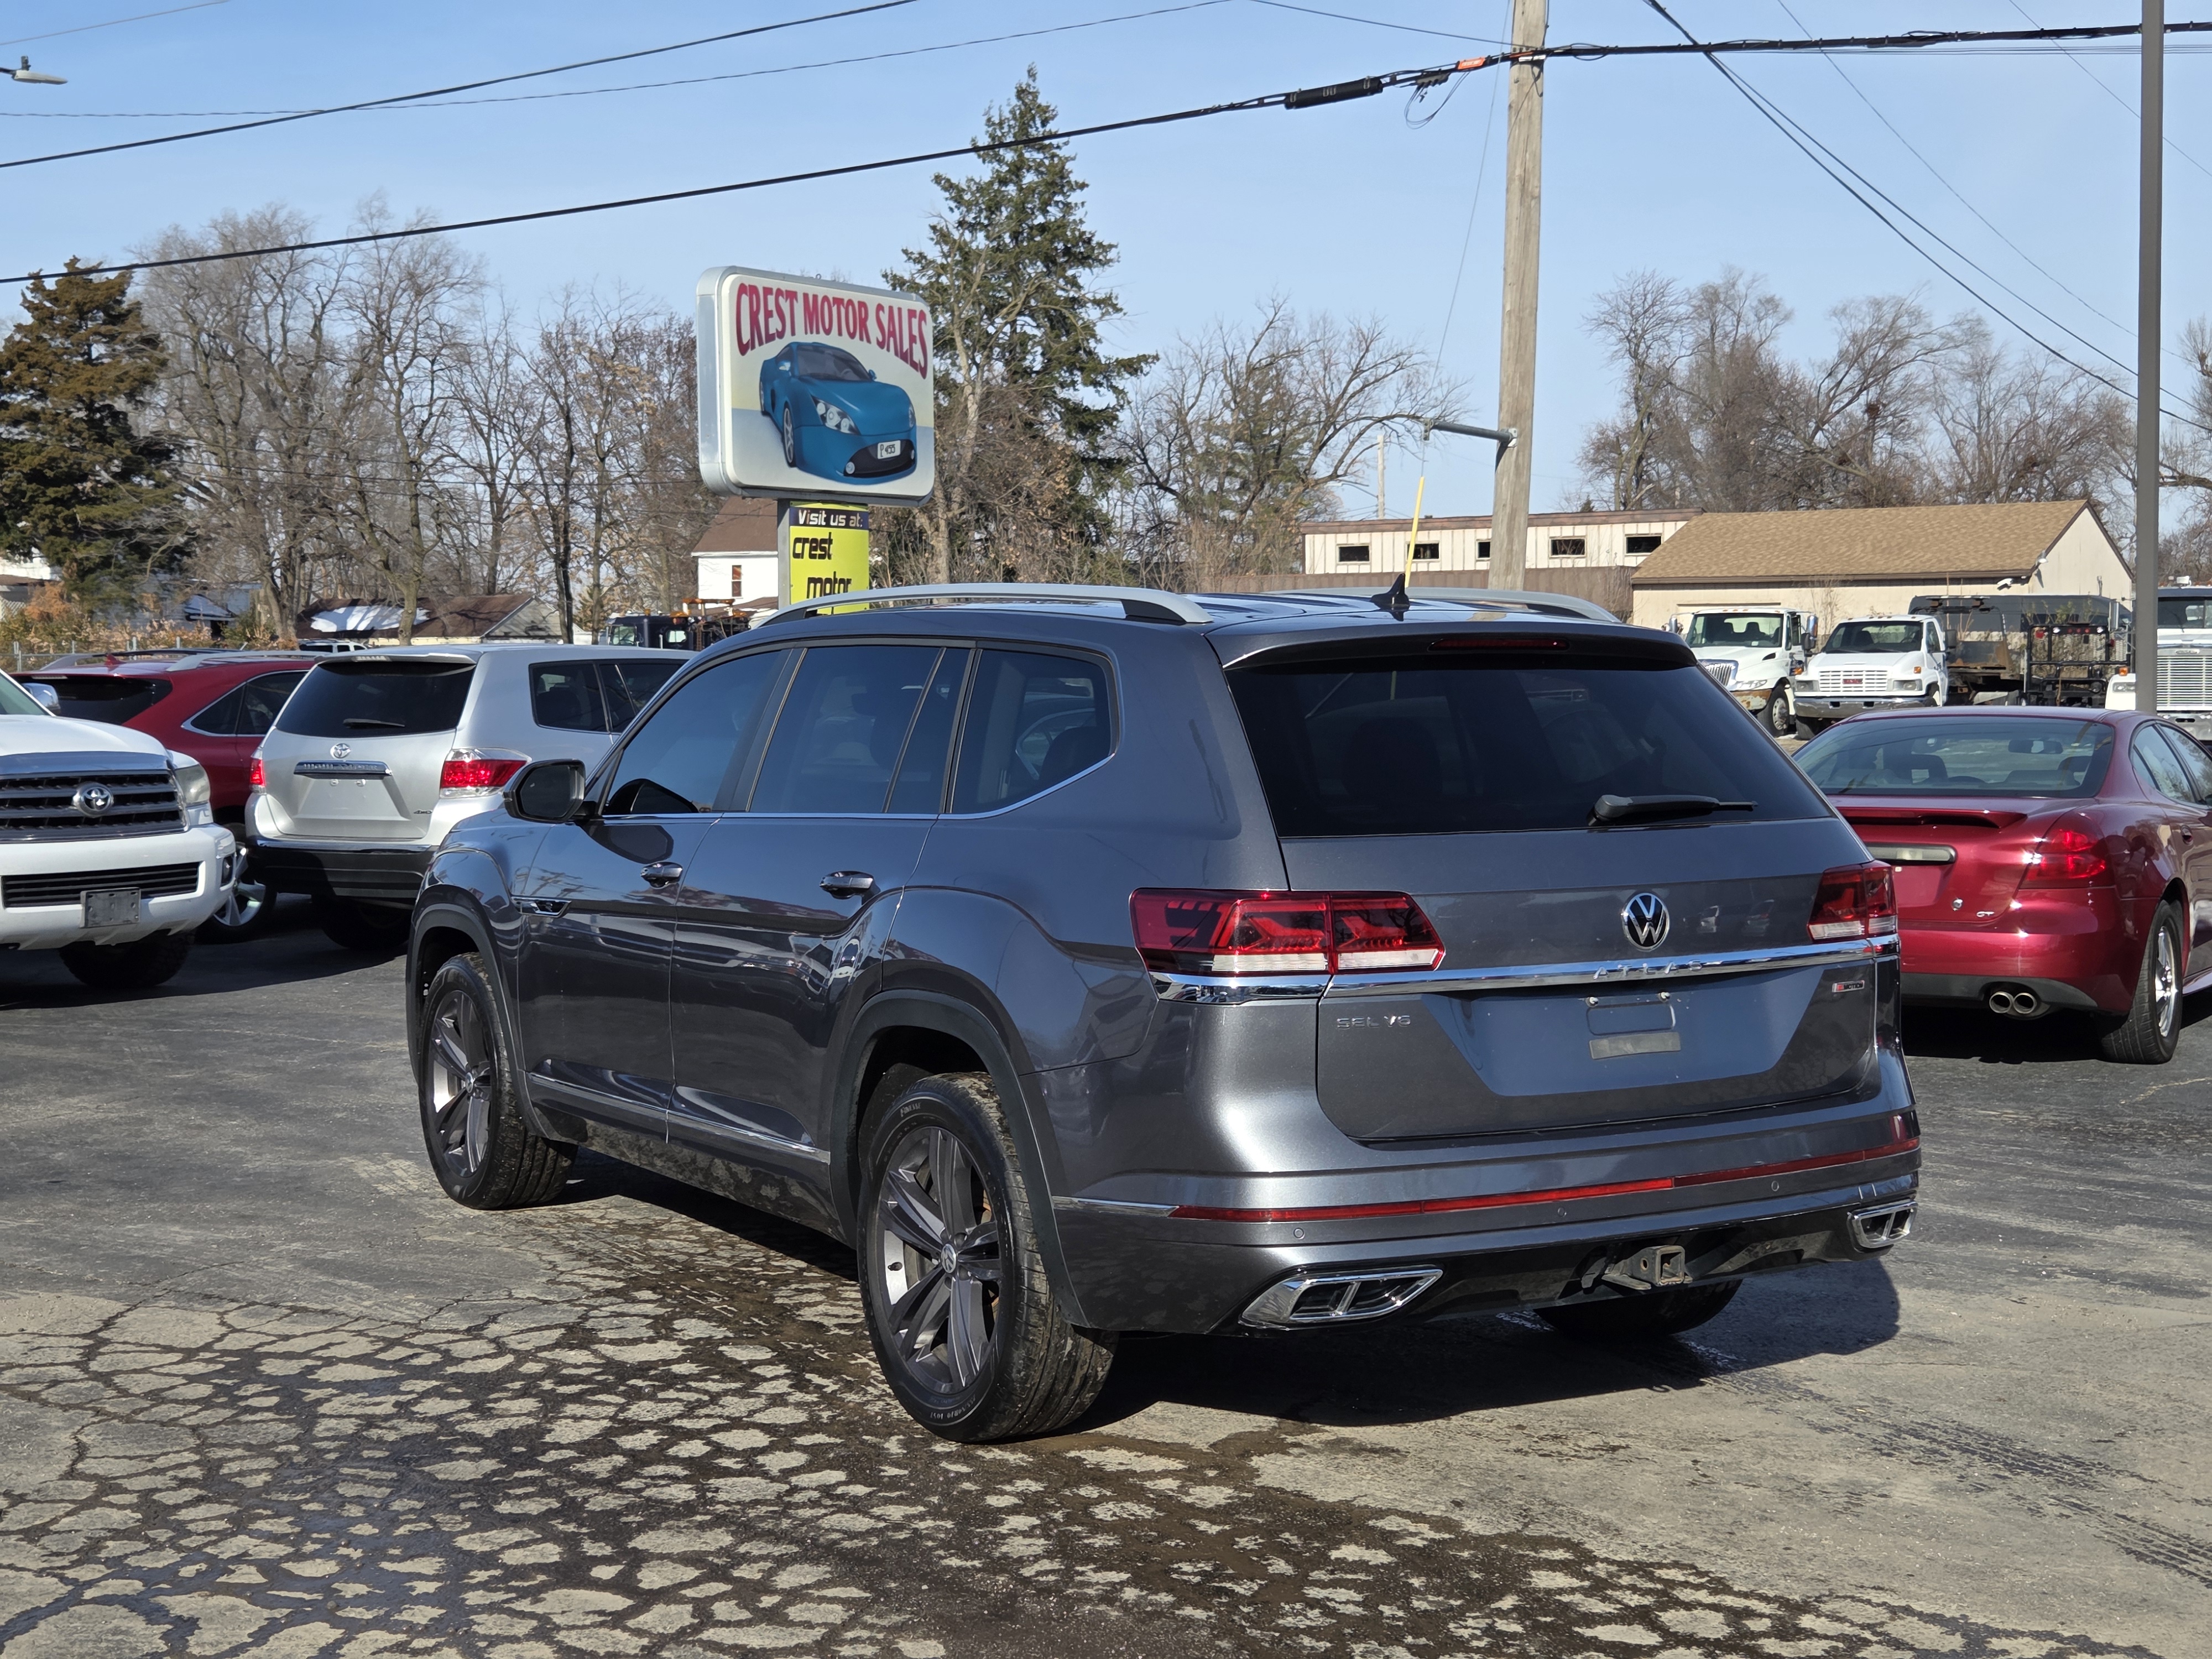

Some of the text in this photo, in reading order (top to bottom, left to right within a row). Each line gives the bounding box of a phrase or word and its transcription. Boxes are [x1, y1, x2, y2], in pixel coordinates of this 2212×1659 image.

[736, 283, 928, 379] CREST MOTOR SALES
[799, 509, 863, 527] Visit us at:
[792, 531, 833, 560] crest
[806, 571, 852, 599] motor
[1593, 959, 1703, 979] ATLAS
[1337, 1015, 1411, 1030] SEL V6
